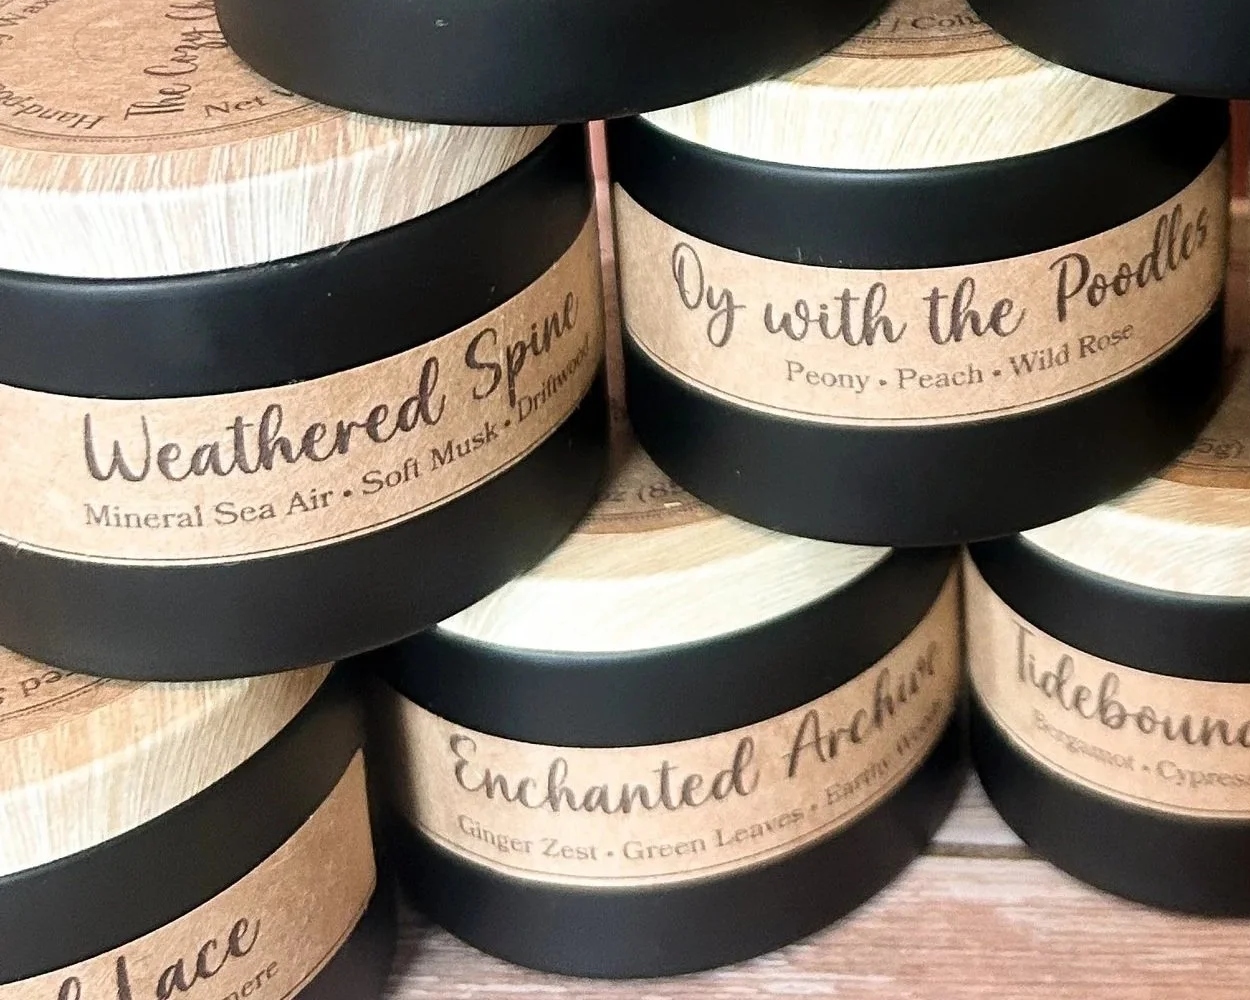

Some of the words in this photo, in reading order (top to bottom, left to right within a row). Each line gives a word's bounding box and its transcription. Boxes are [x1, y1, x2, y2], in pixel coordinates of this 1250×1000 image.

[123, 81, 193, 121] The
[204, 96, 268, 119] Net
[672, 242, 747, 349] Oy
[764, 281, 907, 347] with
[924, 277, 1026, 346] the
[1048, 202, 1212, 323] Poodles
[83, 357, 446, 483] Weathered
[465, 291, 579, 408] Spine
[784, 358, 871, 394] Peony
[898, 363, 985, 389] Peach
[1008, 343, 1071, 379] Wild
[1079, 322, 1135, 361] Rose
[83, 502, 203, 529] Mineral
[214, 501, 277, 527] Sea
[285, 486, 335, 520] Air
[362, 455, 421, 496] Soft
[430, 421, 499, 473] Musk
[518, 331, 591, 423] Driftwood
[448, 731, 762, 817] Enchanted
[457, 812, 532, 856] Ginger
[541, 835, 599, 862] Zest
[622, 834, 708, 861] Green
[715, 806, 805, 848] Leaves
